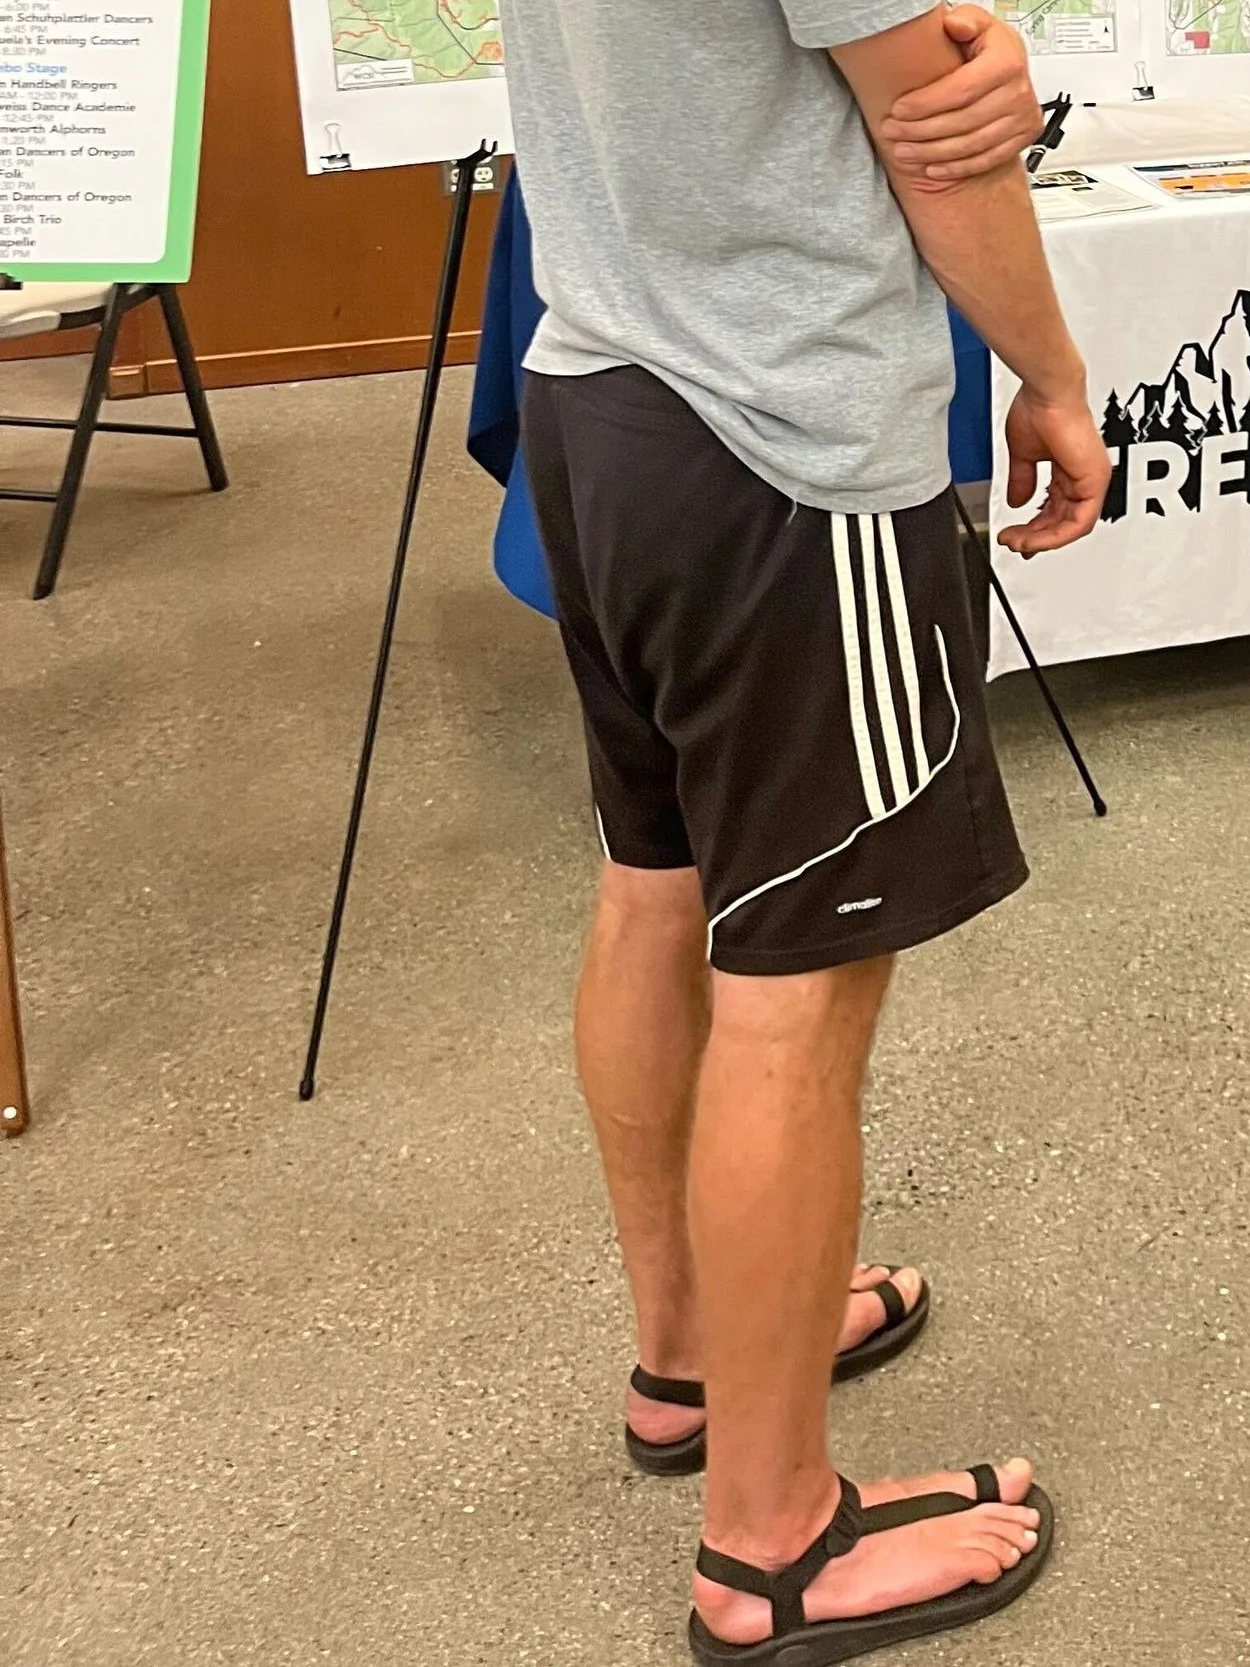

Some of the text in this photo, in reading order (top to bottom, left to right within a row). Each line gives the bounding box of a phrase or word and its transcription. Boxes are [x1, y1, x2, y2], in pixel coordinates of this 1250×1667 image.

[104, 14, 154, 24] Dancers
[37, 35, 86, 47] Evening
[90, 36, 141, 46] Concert
[26, 62, 67, 76] Stage
[10, 79, 67, 89] Handbell
[71, 80, 118, 92] Ringers
[0, 102, 136, 112] weiss Dance Academie
[0, 124, 106, 135] nworth Alphorns
[16, 147, 66, 157] Dancers
[70, 146, 84, 157] of
[88, 147, 136, 159] Oregon
[12, 192, 62, 202] Dancers
[67, 191, 81, 202] of
[84, 192, 132, 204] Oregon
[4, 214, 62, 224] Birch Trio
